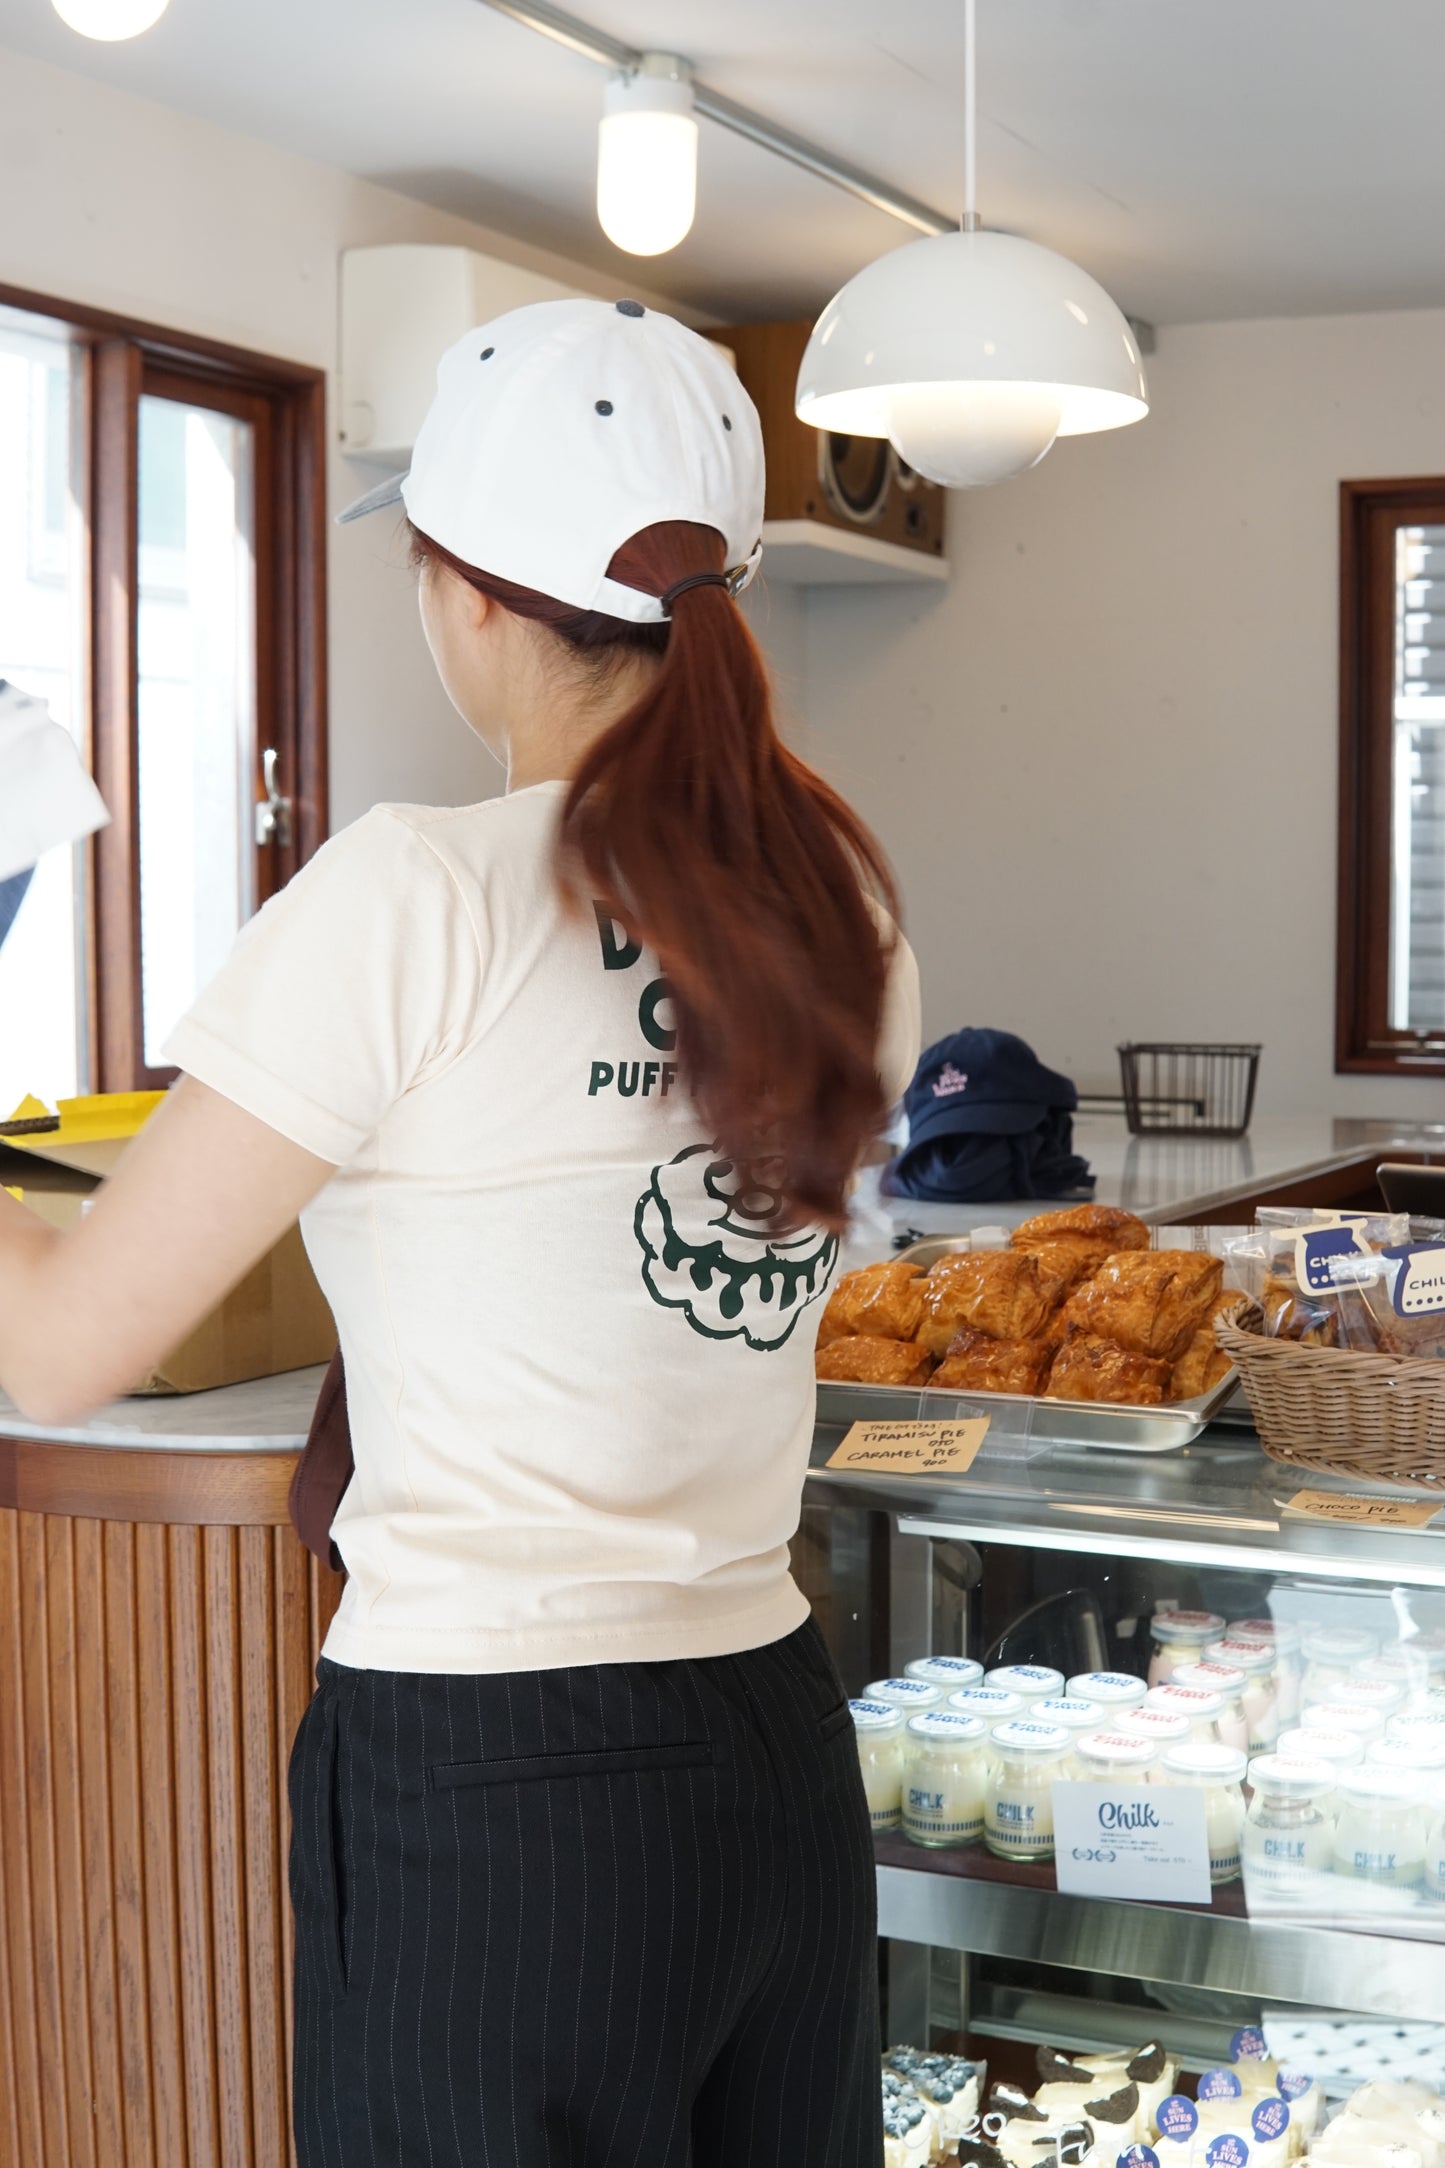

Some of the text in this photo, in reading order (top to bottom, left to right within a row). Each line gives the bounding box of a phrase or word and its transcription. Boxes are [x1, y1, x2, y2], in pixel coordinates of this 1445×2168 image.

[588, 1061, 678, 1098] PUFF
[861, 1429, 967, 1442] TIRAMISU PIE
[847, 1447, 961, 1461] CARAMEL PIE
[1305, 1503, 1361, 1511] CHOCO
[908, 1788, 944, 1809] CHILK
[1098, 1801, 1160, 1830] Chilk
[1205, 2085, 1235, 2098] LIVES
[1167, 2106, 1184, 2116] SUN
[1162, 2112, 1192, 2127] LIVES
[1258, 2110, 1283, 2131] LIVES
[1167, 2124, 1192, 2135] HERE
[1256, 2120, 1277, 2137] HERE
[1221, 2143, 1239, 2155] SUN
[1212, 2151, 1243, 2167] LIVES
